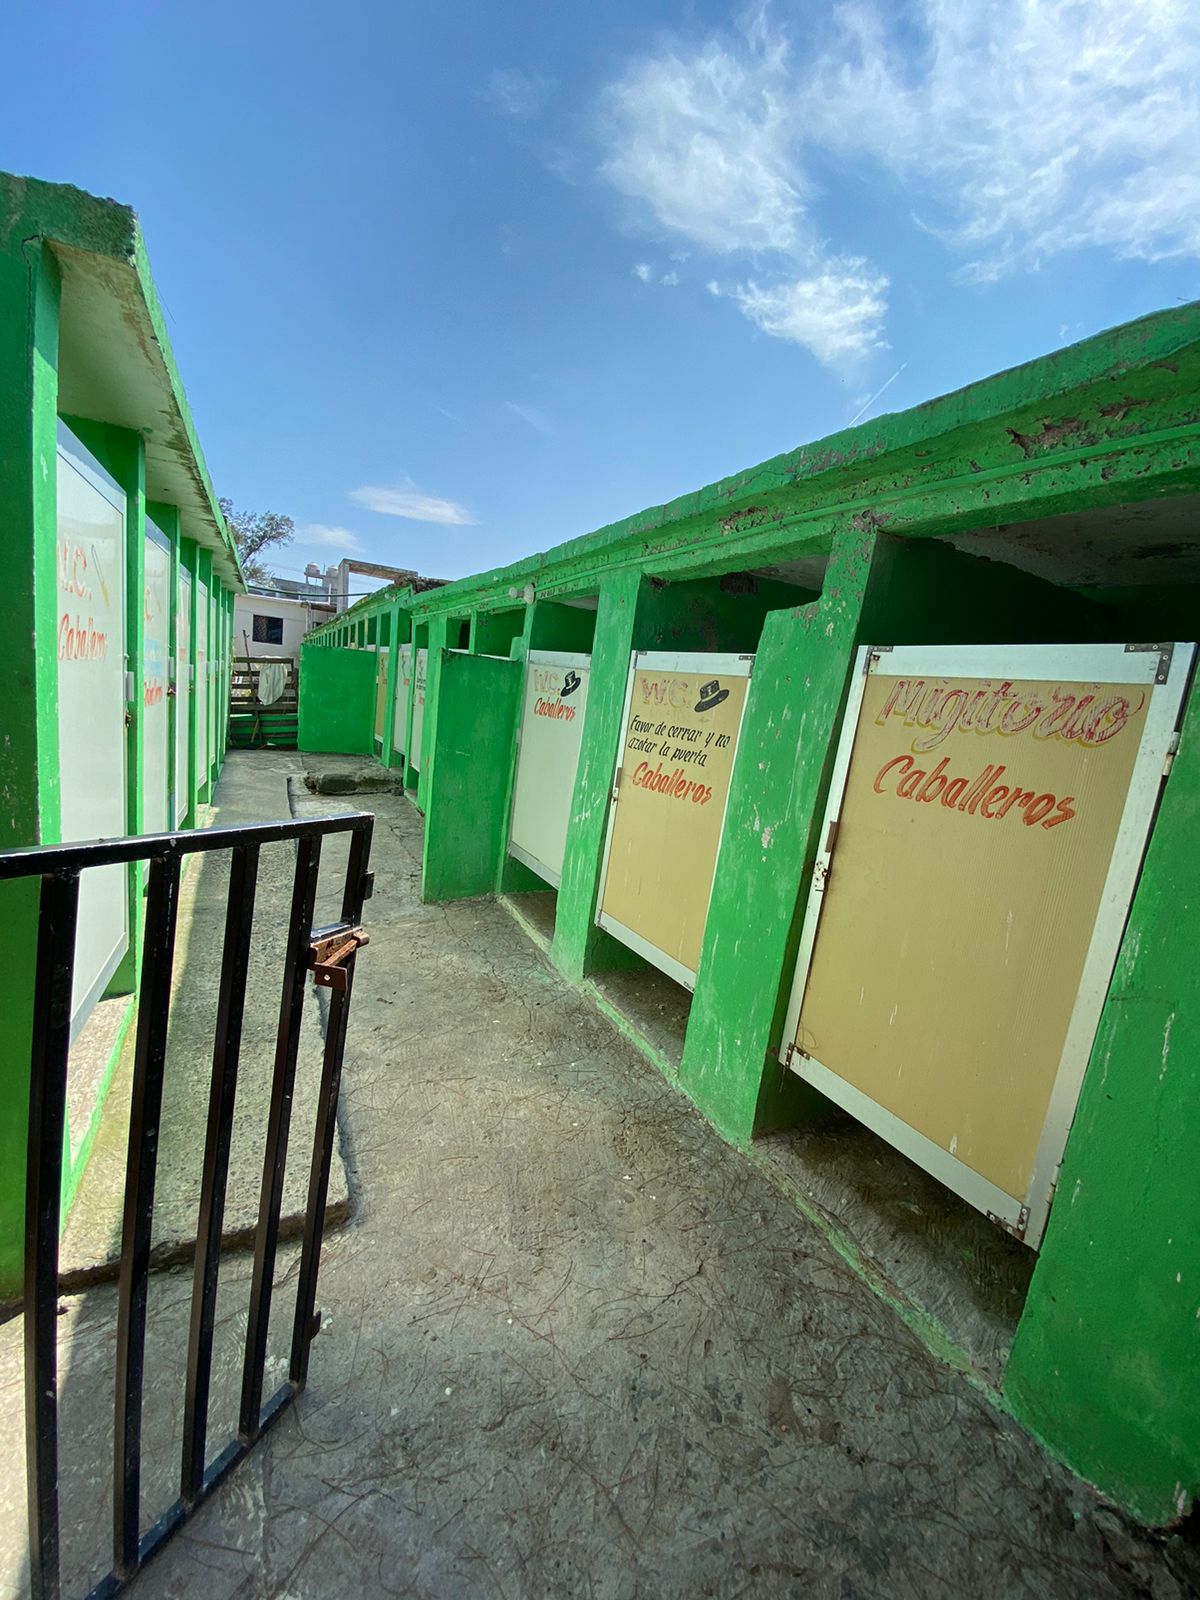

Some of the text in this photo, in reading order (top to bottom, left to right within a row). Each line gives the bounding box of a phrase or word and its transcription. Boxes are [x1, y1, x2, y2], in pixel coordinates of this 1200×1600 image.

[533, 697, 577, 721] Caballeros
[630, 715, 731, 749] Favor de cerrar y no
[627, 737, 708, 767] azotar la puerta
[632, 761, 712, 805] Caballeros
[873, 754, 1076, 830] Caballeros
